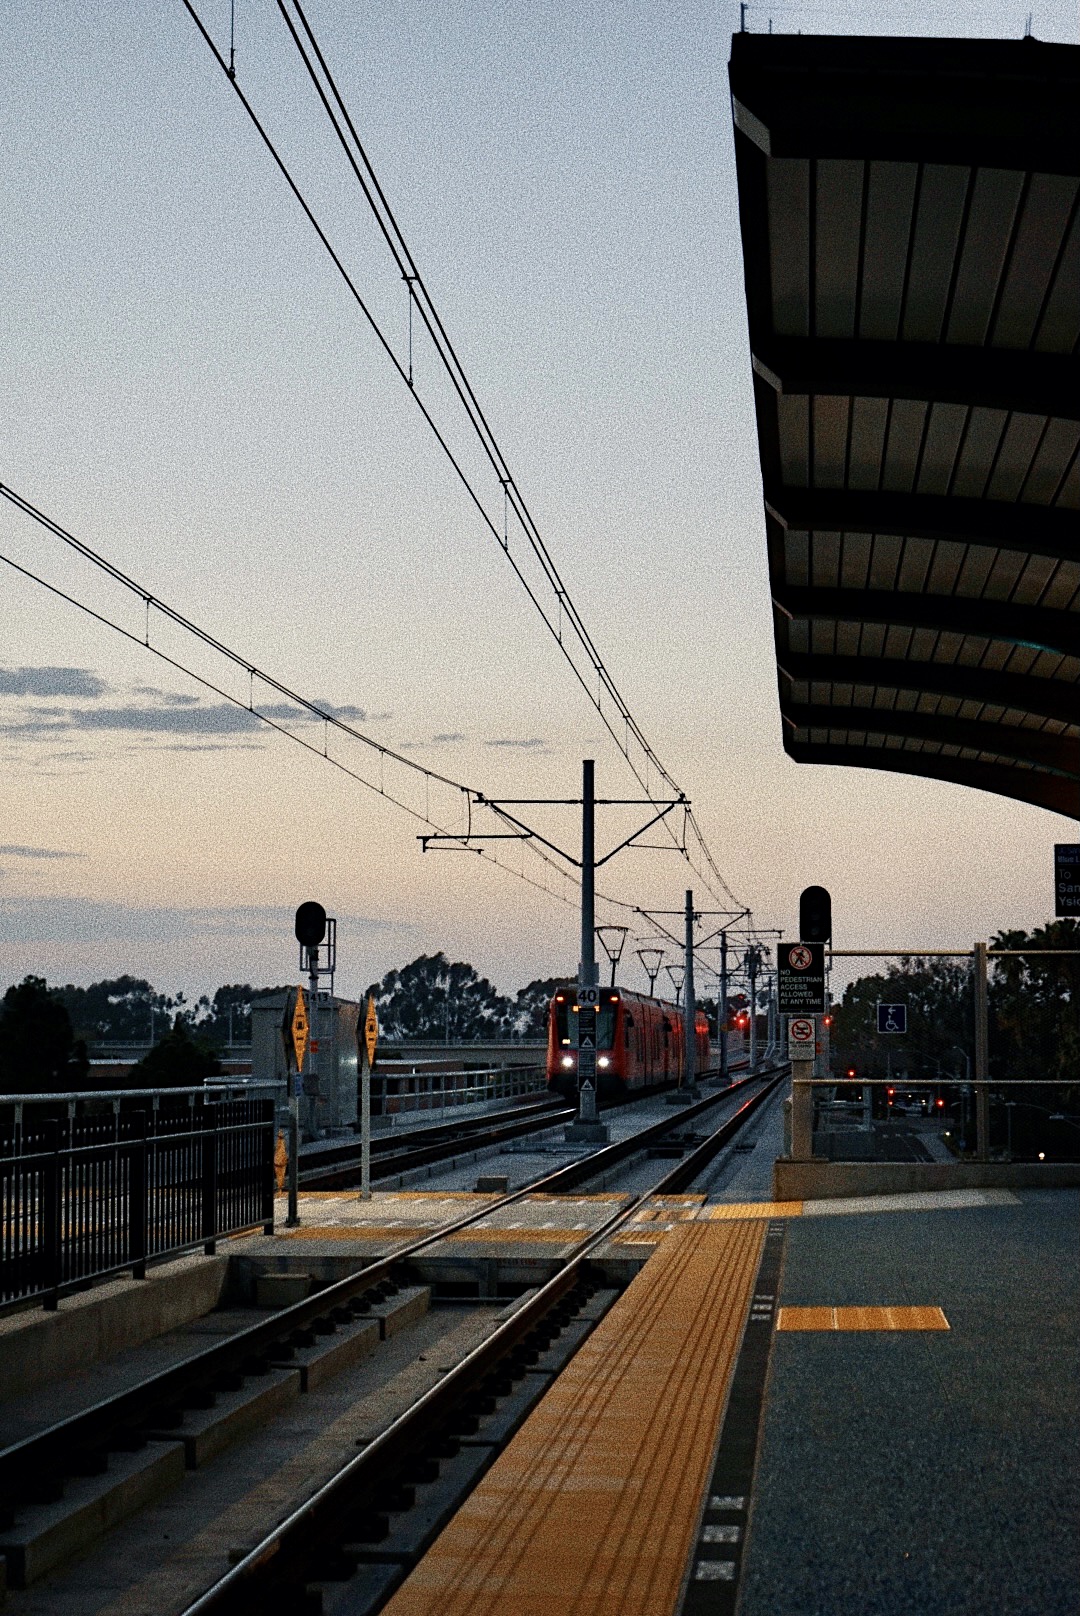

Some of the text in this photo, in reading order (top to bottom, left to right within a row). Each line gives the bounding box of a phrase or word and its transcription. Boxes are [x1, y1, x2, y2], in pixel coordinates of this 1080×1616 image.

[1058, 868, 1071, 879] To
[1058, 882, 1080, 893] San
[578, 990, 597, 1002] 40
[780, 990, 814, 998] ALLOWED
